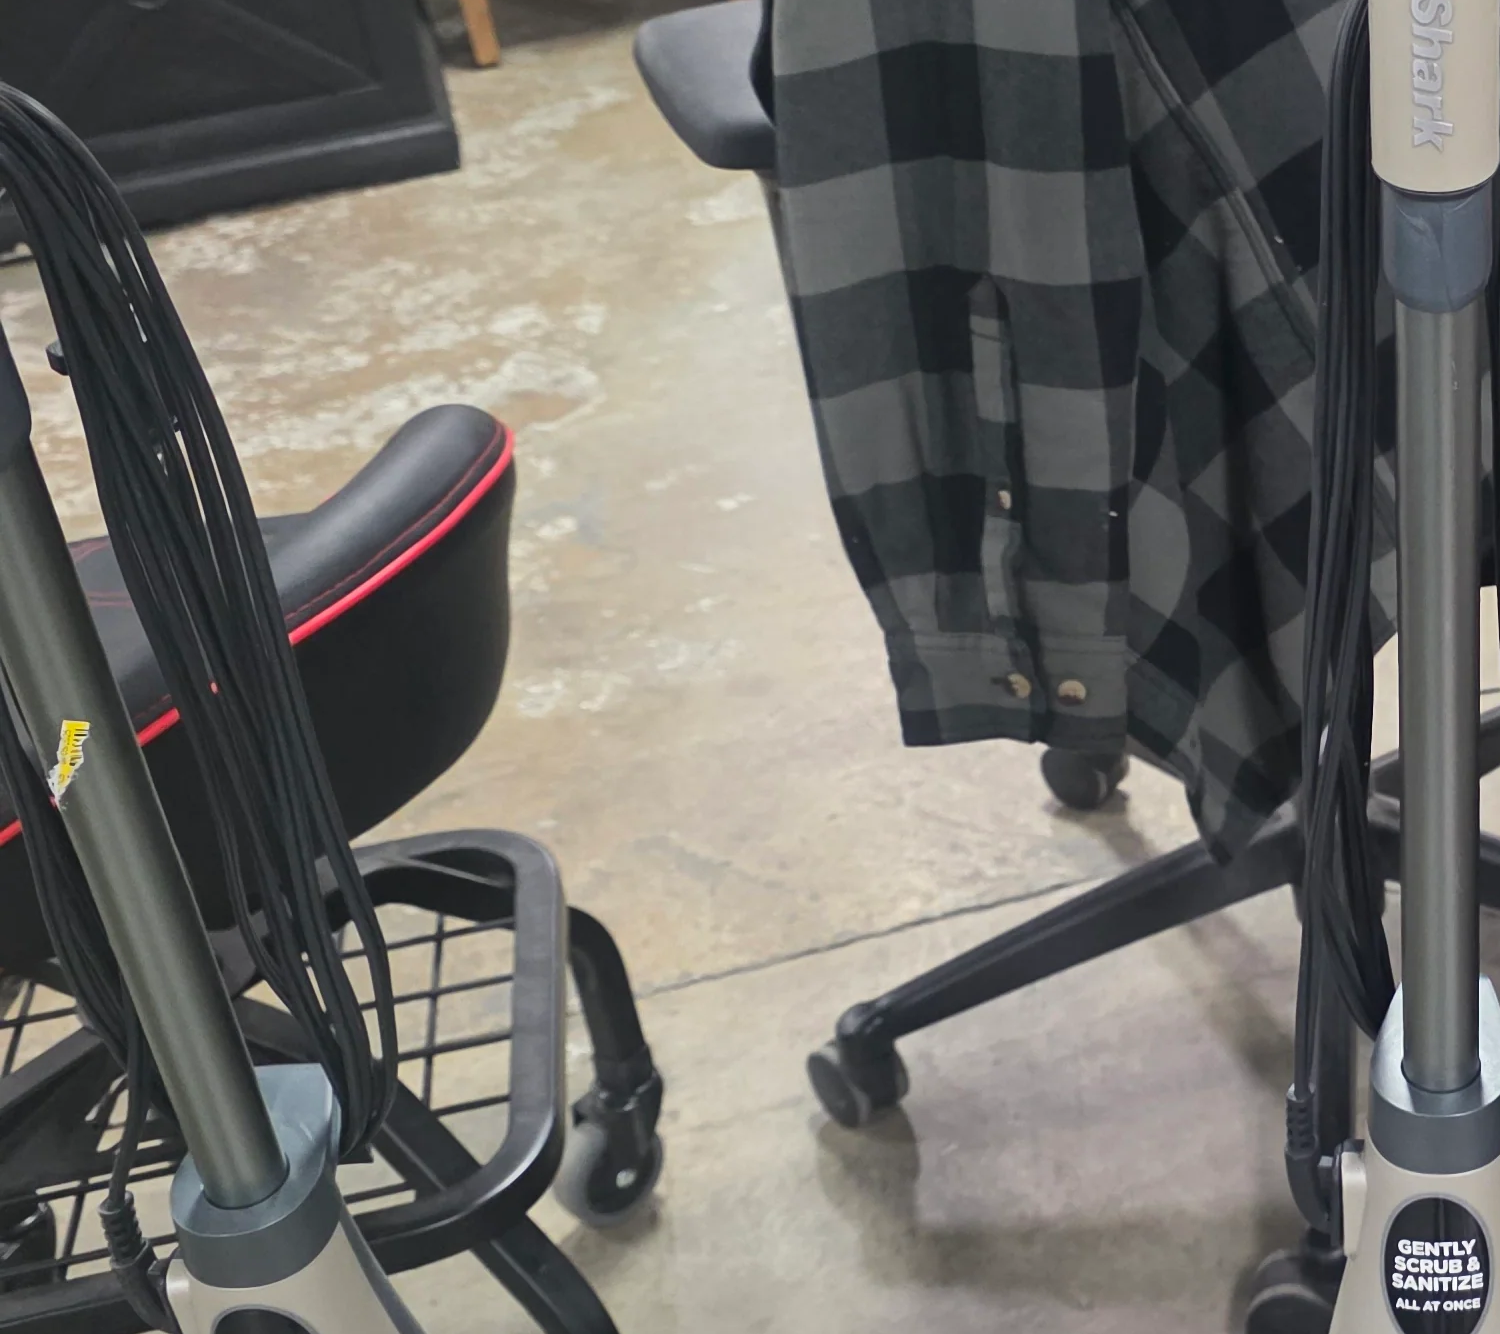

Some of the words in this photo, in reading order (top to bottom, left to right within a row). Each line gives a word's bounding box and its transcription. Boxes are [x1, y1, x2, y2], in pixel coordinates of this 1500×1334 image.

[1397, 1238, 1477, 1257] GENTLY
[1394, 1256, 1463, 1275] SCRUB
[1466, 1256, 1481, 1273] &
[1391, 1272, 1484, 1291] SANITIZE
[1395, 1297, 1421, 1311] ALL
[1422, 1299, 1440, 1312] AT
[1443, 1297, 1481, 1311] ONCE
